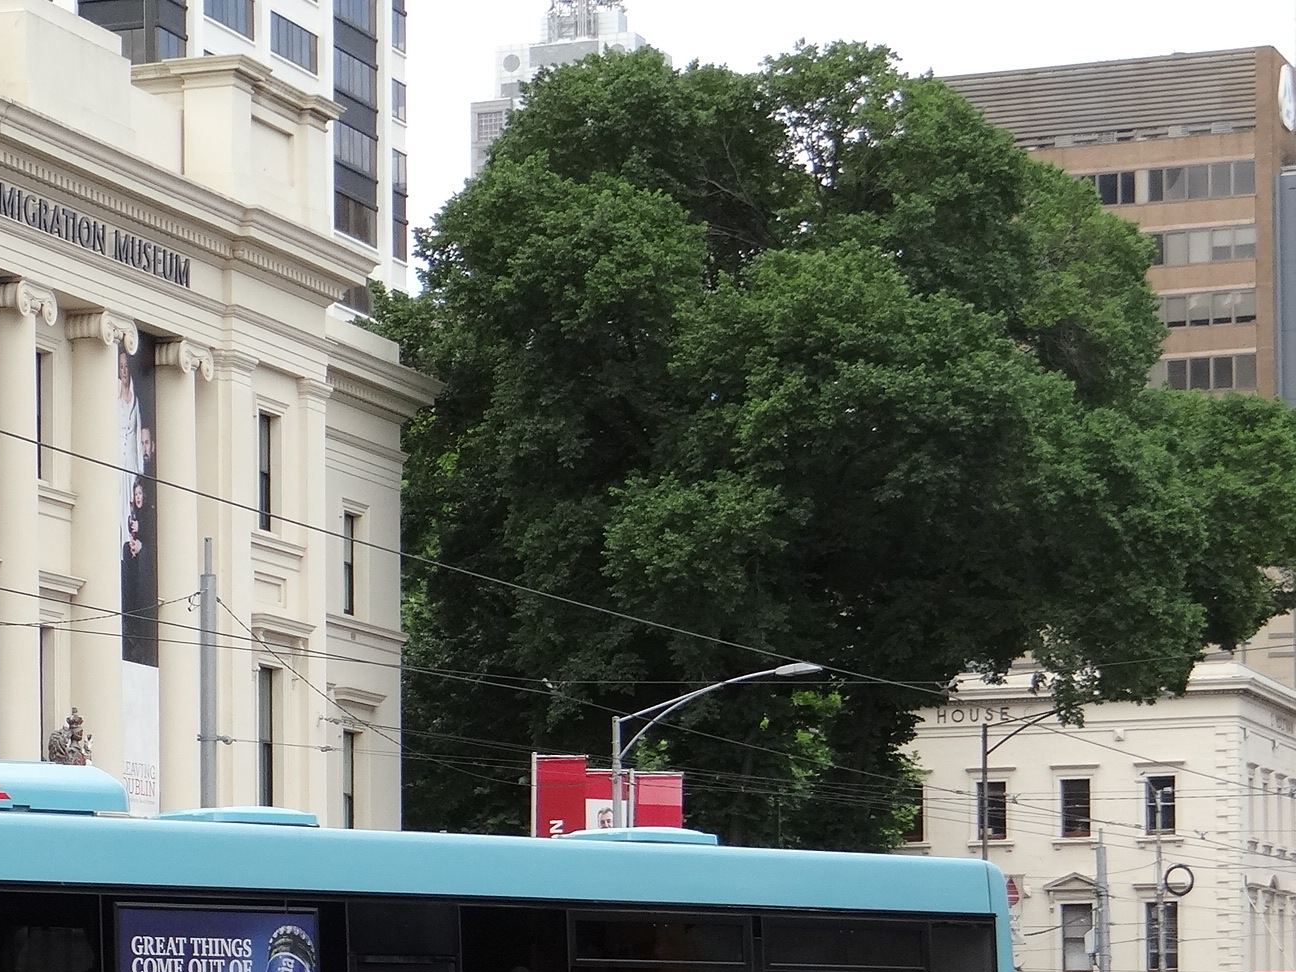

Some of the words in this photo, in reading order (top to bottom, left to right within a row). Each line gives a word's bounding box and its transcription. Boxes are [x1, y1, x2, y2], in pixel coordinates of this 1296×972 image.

[114, 229, 190, 288] MUSEUM
[936, 707, 1009, 724] HOUSE
[131, 936, 187, 956] GREAT
[190, 938, 252, 958] THINGS
